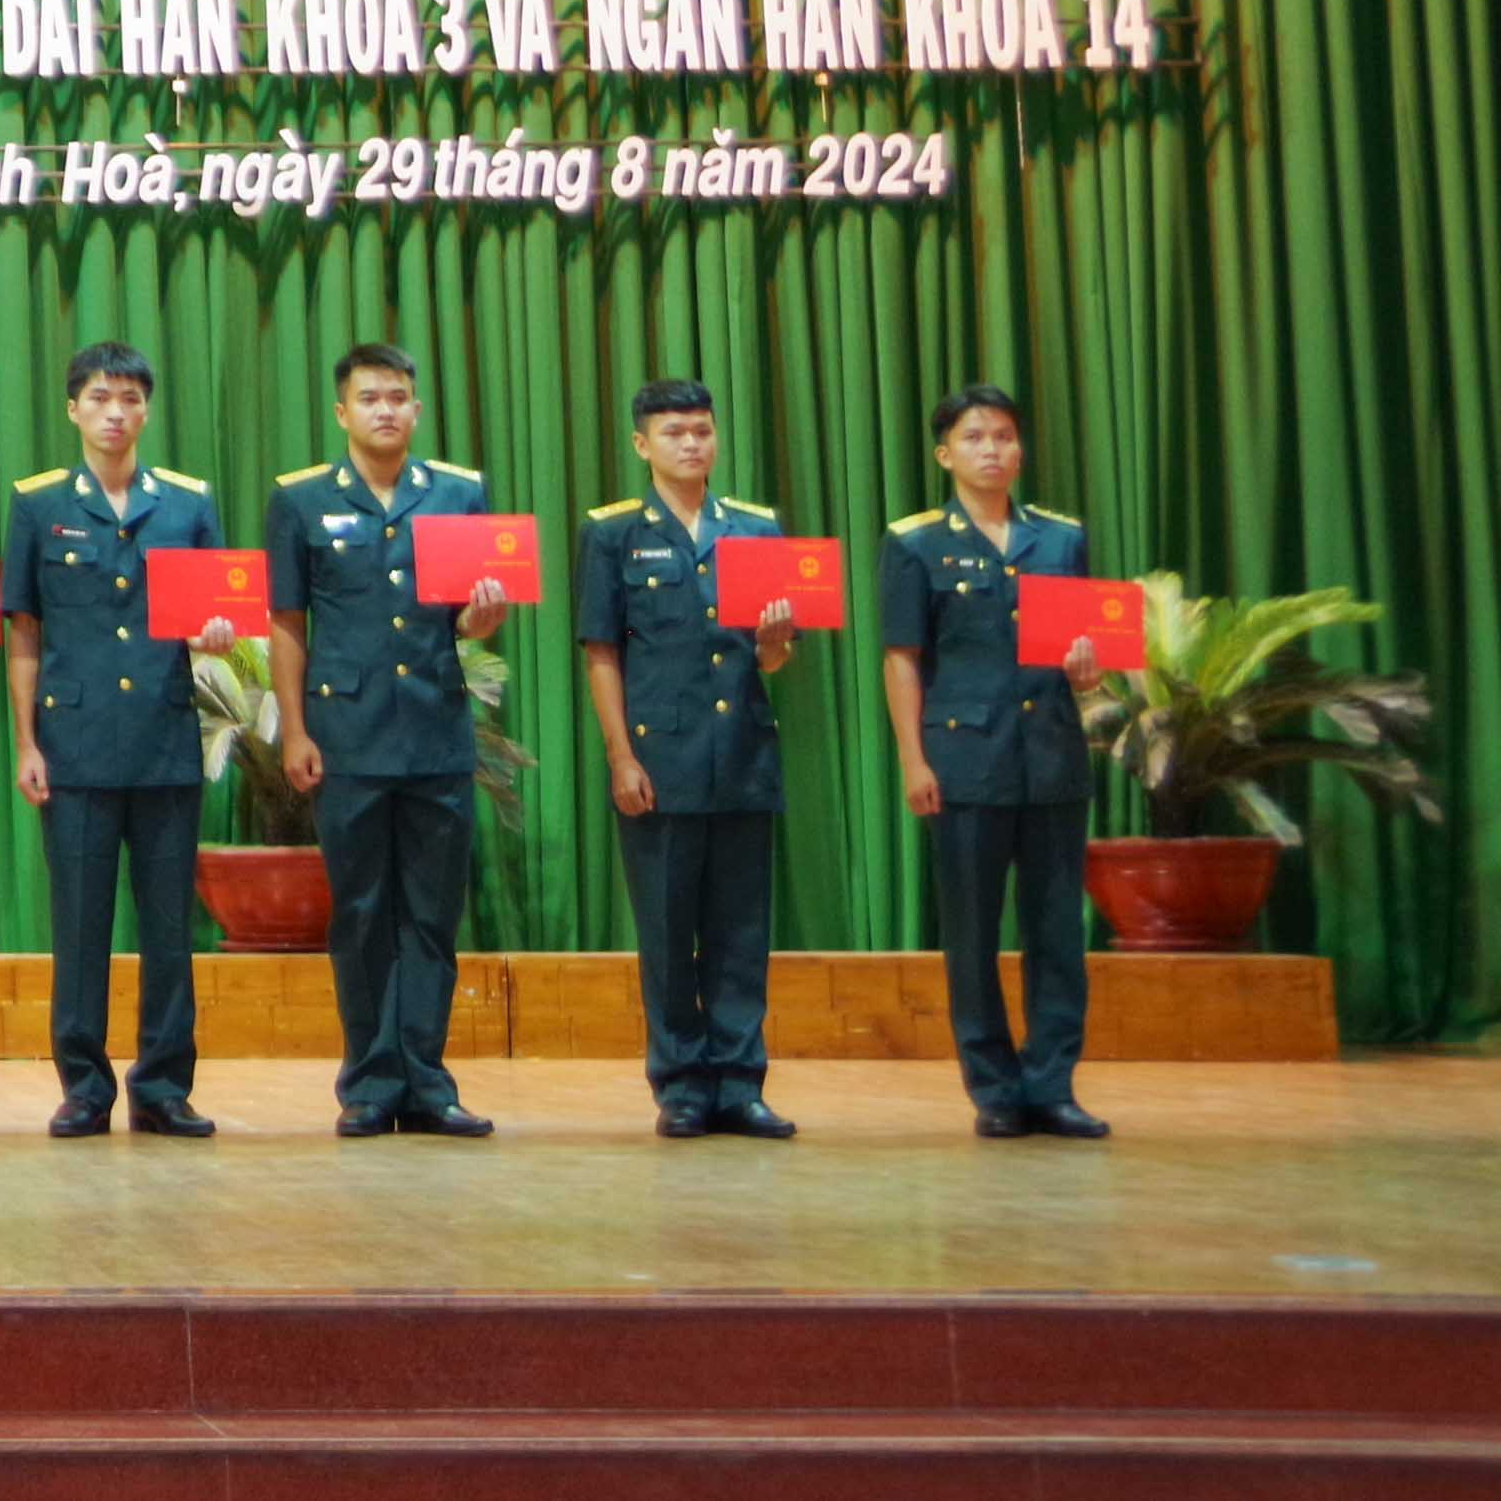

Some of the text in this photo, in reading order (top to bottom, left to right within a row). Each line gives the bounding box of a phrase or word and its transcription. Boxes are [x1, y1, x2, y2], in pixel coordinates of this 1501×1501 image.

[61, 132, 186, 210] Hoà,
[198, 129, 341, 218] ngày
[354, 136, 424, 200] 29
[432, 129, 594, 212] tháng
[610, 135, 648, 198] 8
[661, 129, 785, 197] năm
[802, 132, 947, 197] 2024
